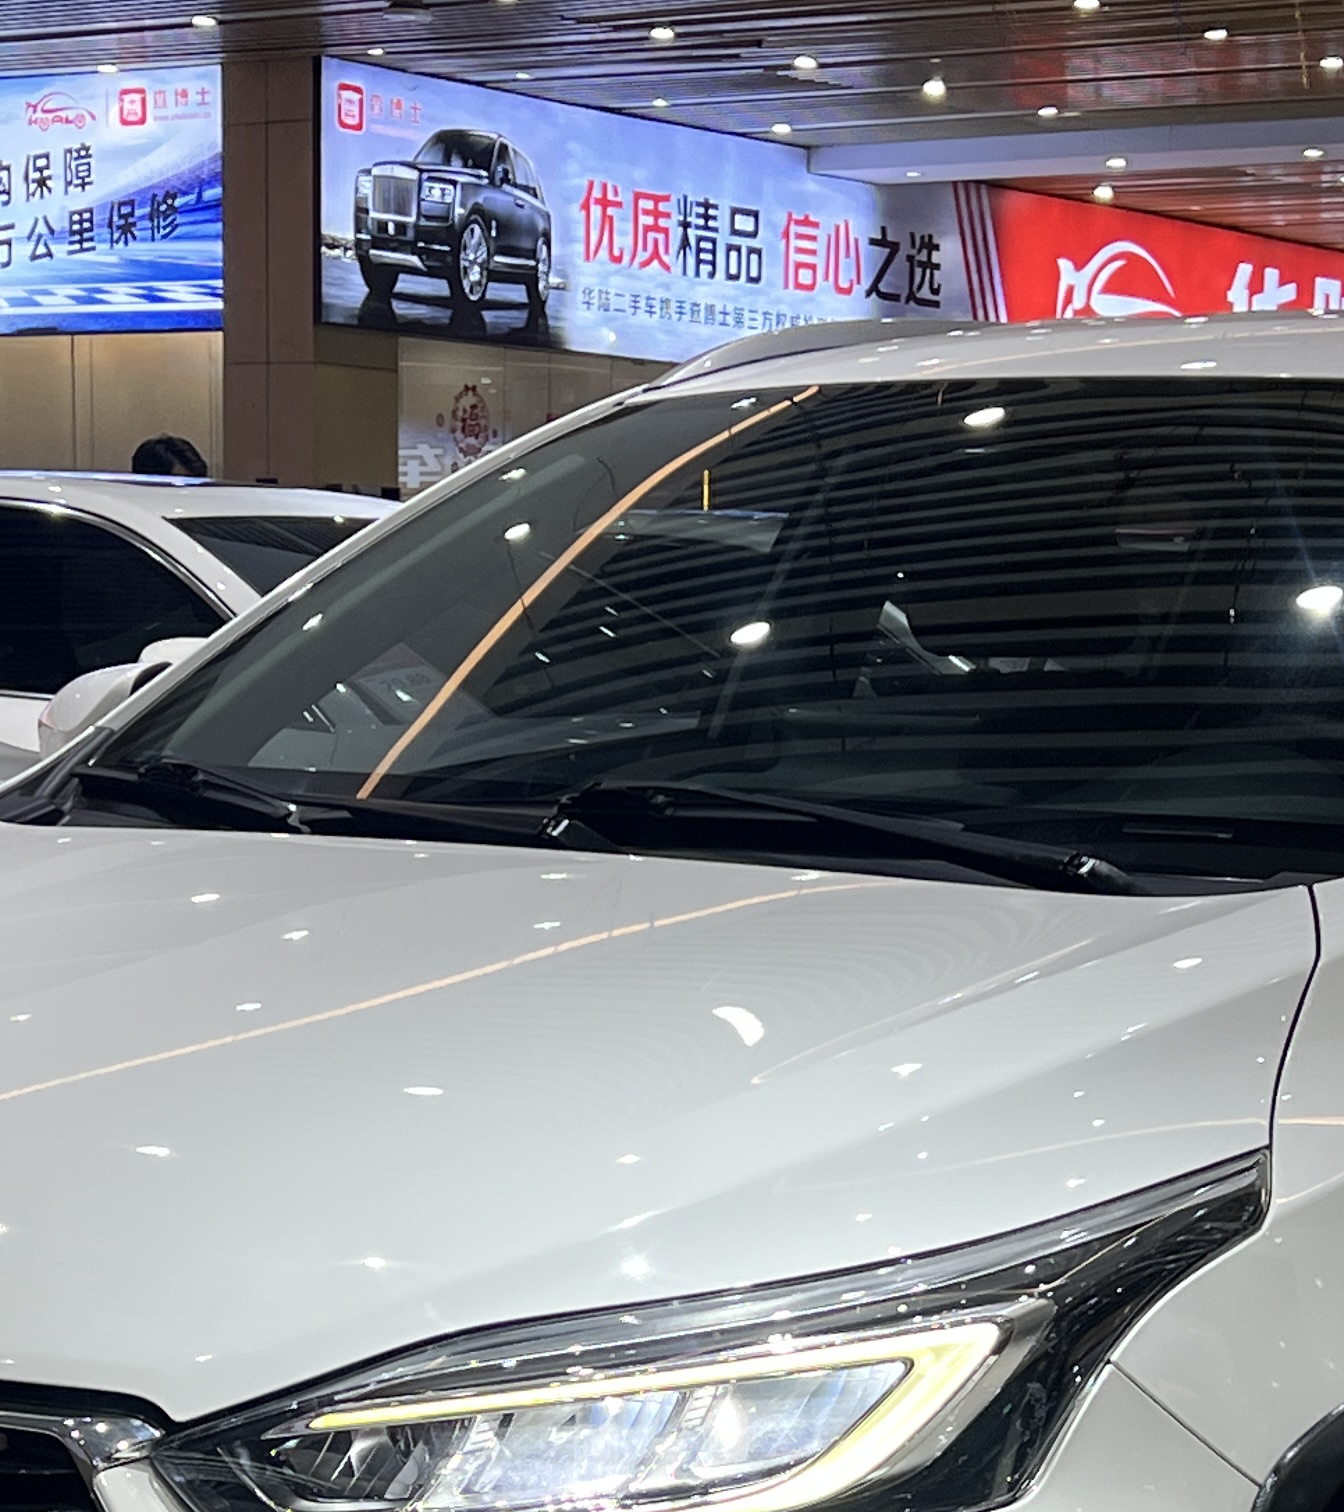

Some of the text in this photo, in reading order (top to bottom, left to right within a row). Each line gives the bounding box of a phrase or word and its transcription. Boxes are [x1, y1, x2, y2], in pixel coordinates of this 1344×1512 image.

[579, 179, 942, 309] 优质精品 信心之选
